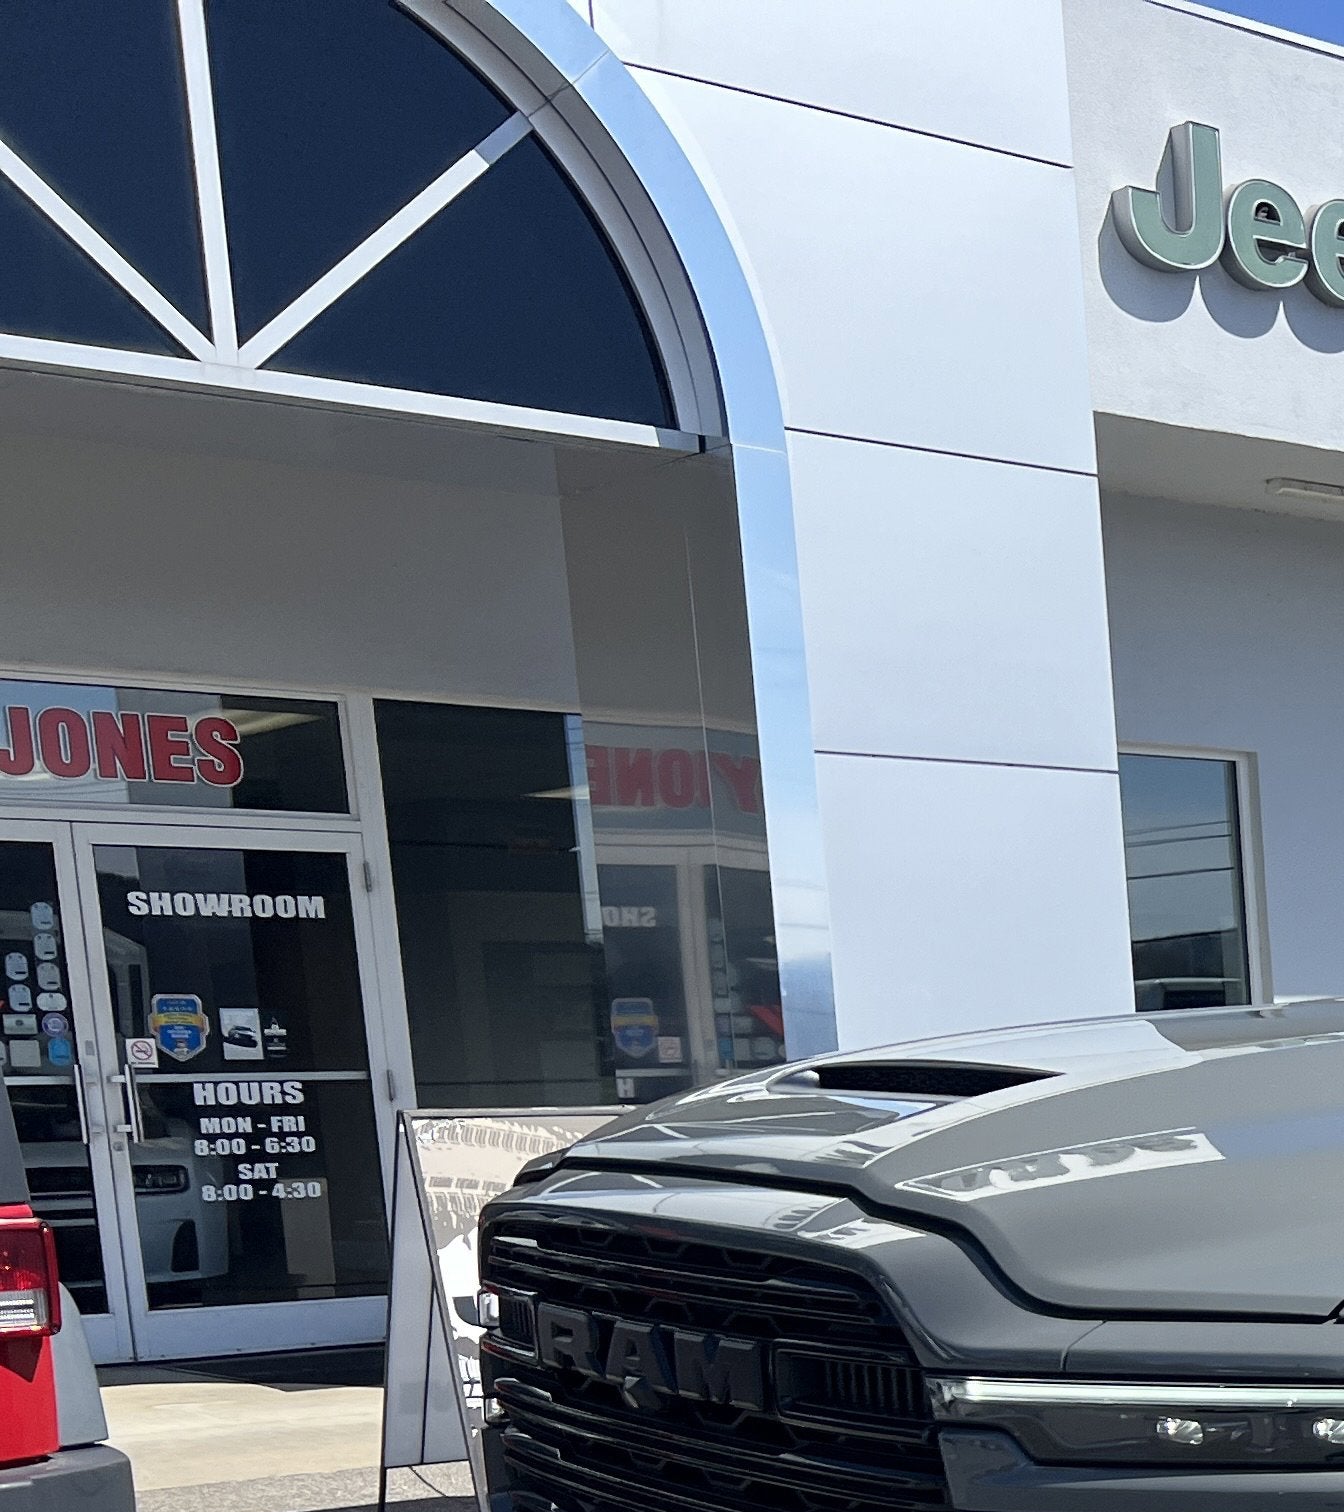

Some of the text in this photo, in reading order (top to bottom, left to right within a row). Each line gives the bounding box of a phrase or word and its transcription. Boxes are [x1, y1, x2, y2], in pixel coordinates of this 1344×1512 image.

[0, 705, 244, 788] JONES
[127, 890, 326, 919] SHOWROOM
[193, 1081, 305, 1106] HOURS
[200, 1116, 253, 1134] MON
[270, 1115, 306, 1133] FRI
[194, 1138, 247, 1156] 8:00
[264, 1136, 317, 1154] 6:30
[237, 1162, 279, 1180] SAT
[201, 1183, 254, 1202] 8:00
[271, 1181, 322, 1199] 4:30
[536, 1301, 764, 1411] RAM
